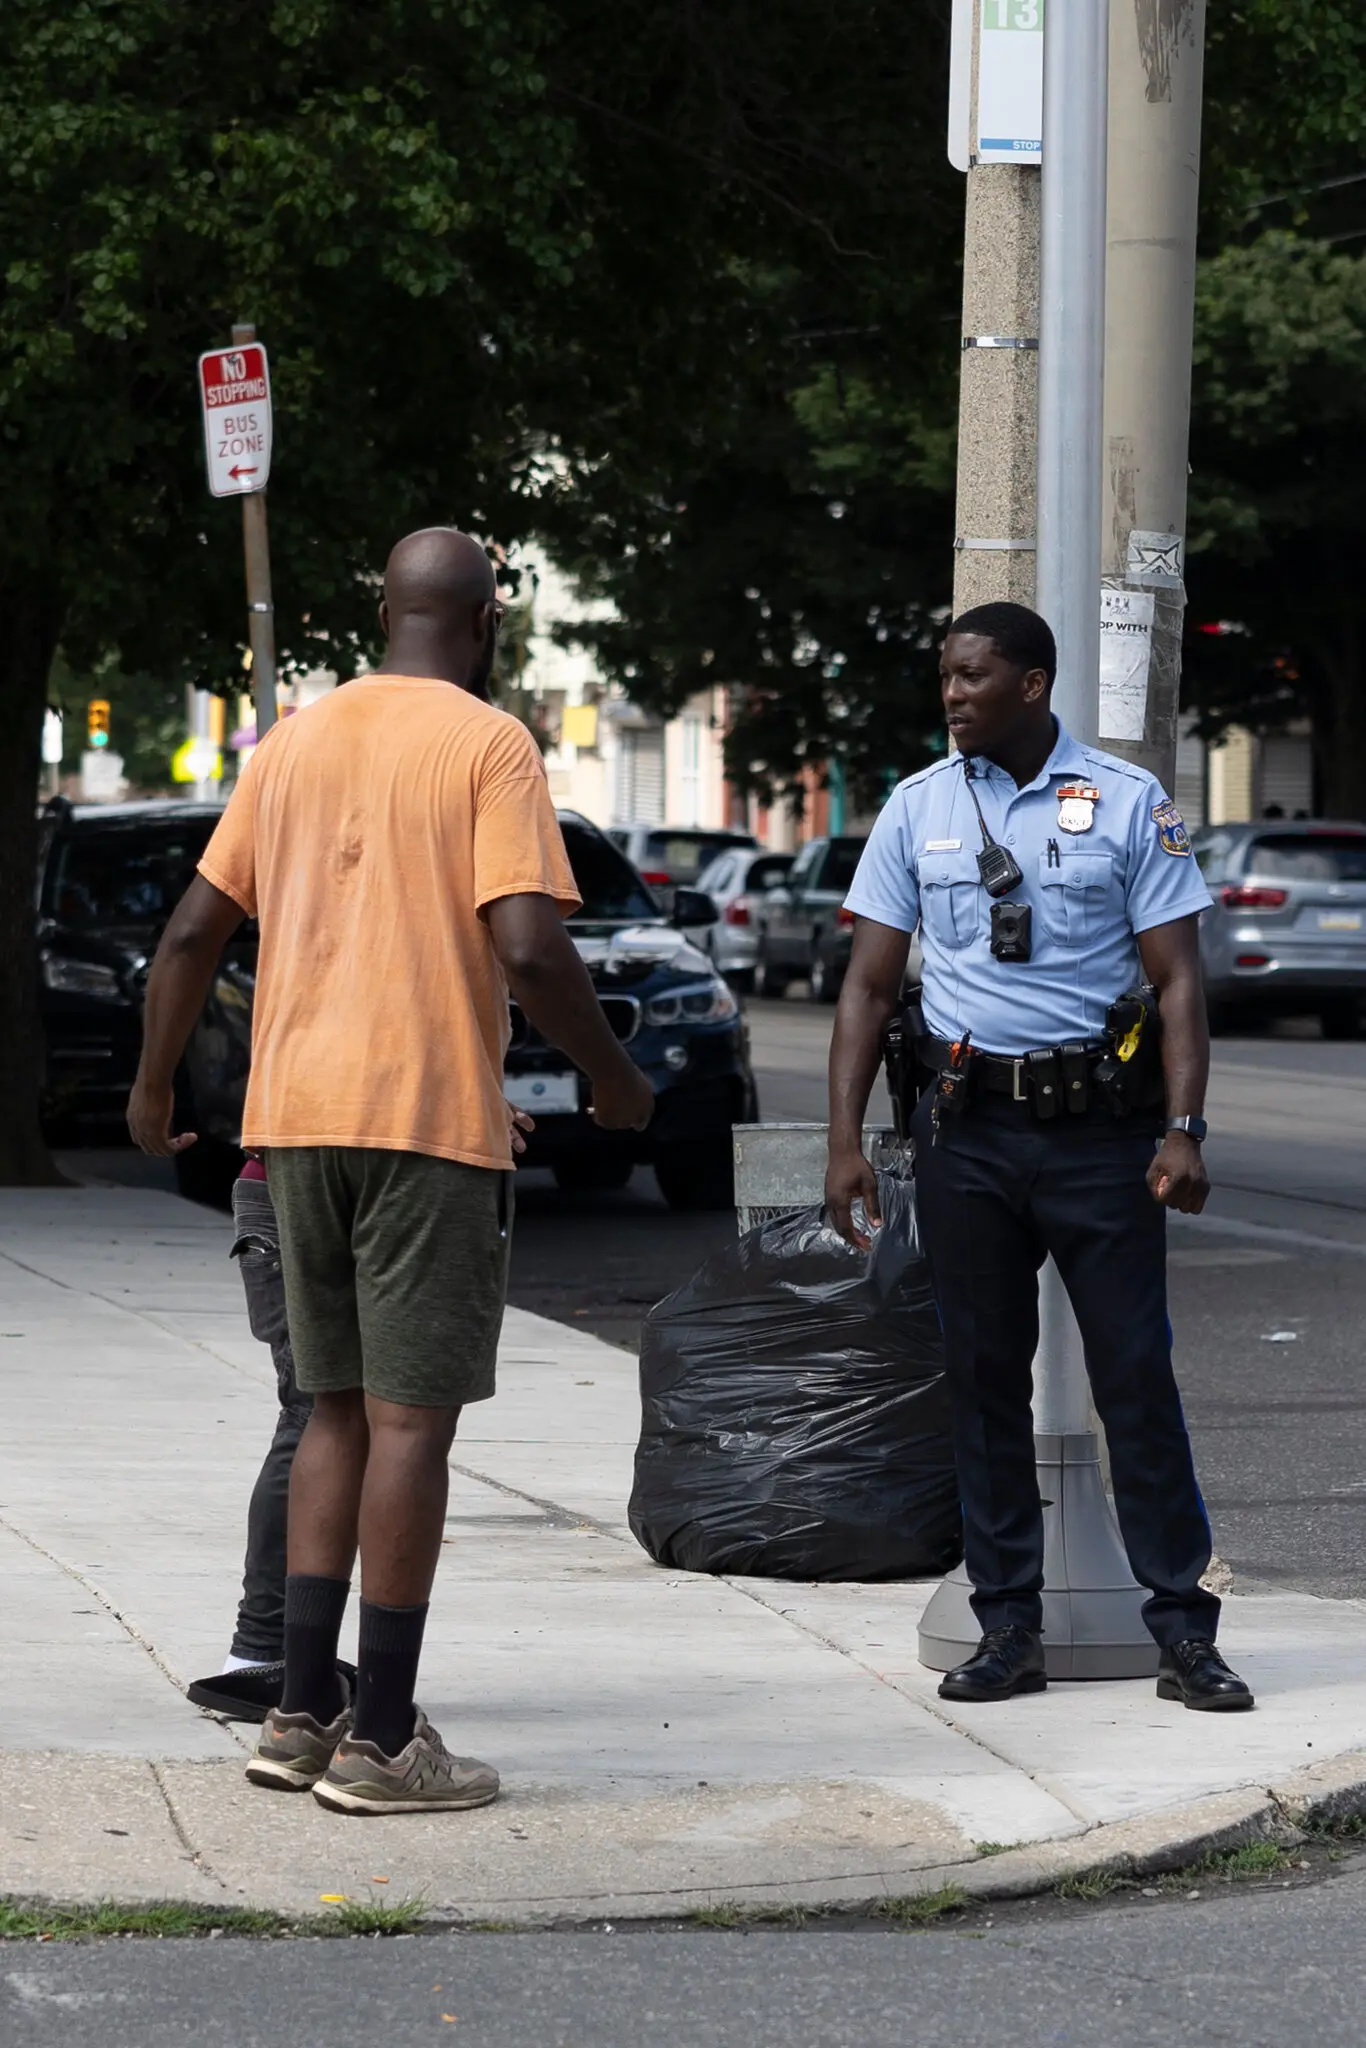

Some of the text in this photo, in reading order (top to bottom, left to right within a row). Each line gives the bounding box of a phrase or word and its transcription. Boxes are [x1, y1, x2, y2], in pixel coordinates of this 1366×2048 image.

[997, 0, 1038, 29] 13
[1012, 140, 1041, 151] STOP
[221, 352, 247, 382] NO
[207, 378, 266, 405] STOPPING
[224, 413, 258, 435] BUS
[218, 434, 263, 458] ZONE
[1116, 622, 1147, 632] WITH
